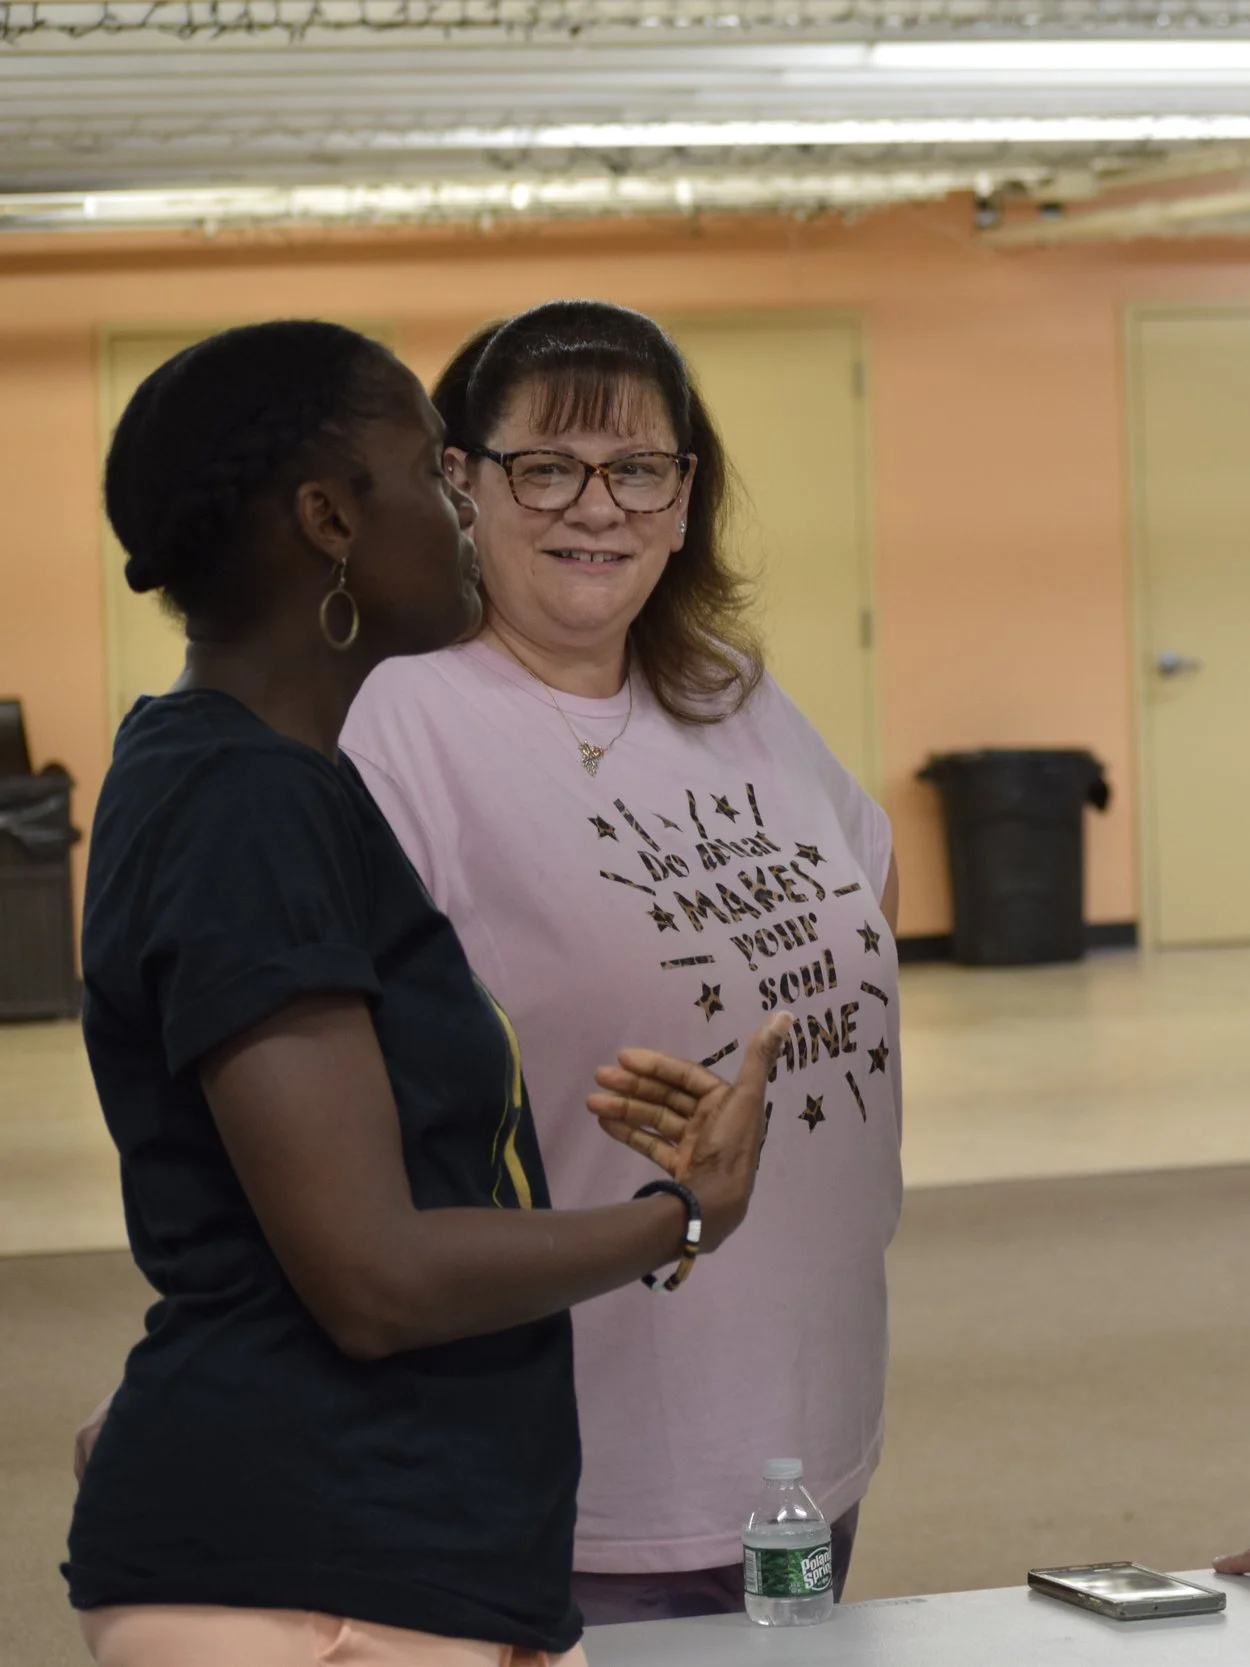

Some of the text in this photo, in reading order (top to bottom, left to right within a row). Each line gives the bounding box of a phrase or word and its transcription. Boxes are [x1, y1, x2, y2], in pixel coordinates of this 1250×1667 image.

[636, 849, 691, 882] Do
[672, 860, 827, 933] MAKES
[729, 911, 818, 972] your
[758, 948, 838, 1011] soul
[767, 1001, 860, 1084] HINE
[800, 1551, 831, 1576] Polan
[803, 1562, 832, 1589] Sprin
